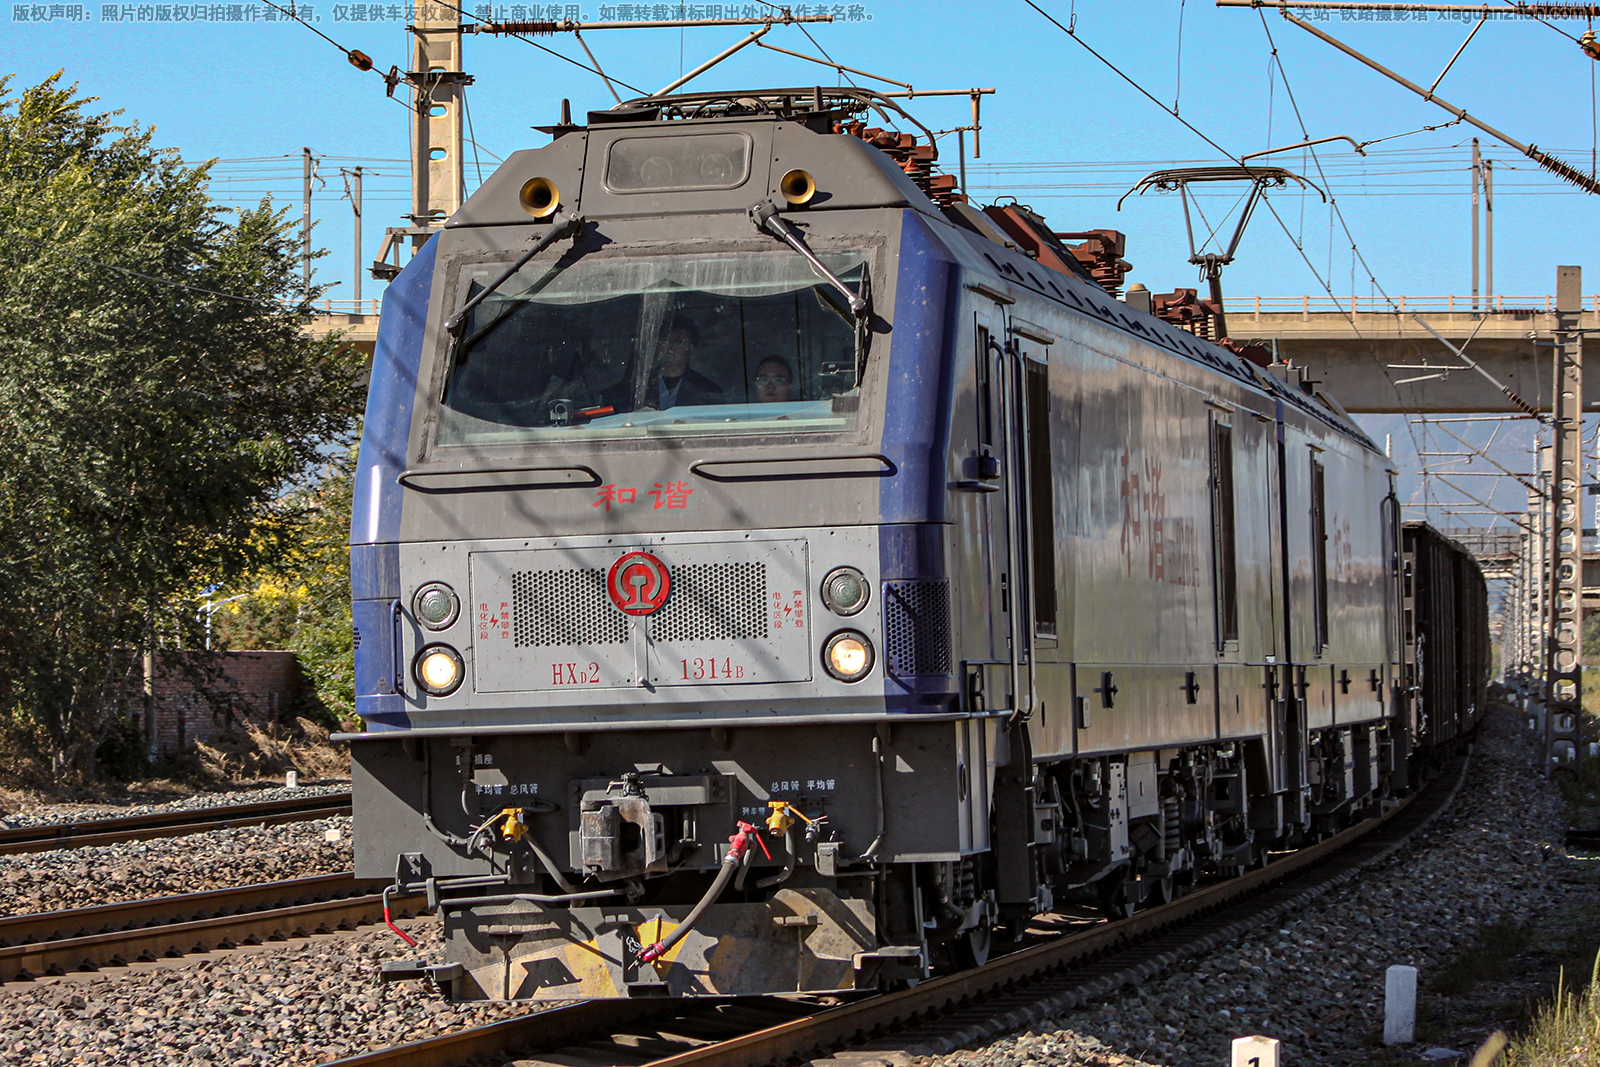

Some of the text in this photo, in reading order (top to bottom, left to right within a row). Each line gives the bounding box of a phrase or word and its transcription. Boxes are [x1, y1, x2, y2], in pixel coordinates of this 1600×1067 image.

[592, 480, 694, 512] 和谐
[479, 602, 489, 640] 电化区段
[500, 602, 510, 639] 严禁攀登
[772, 592, 783, 629] 电化区段
[552, 662, 600, 685] HXD2
[680, 656, 744, 681] 1314B
[475, 783, 538, 795] 平均管 总风管
[771, 779, 836, 792] 总风管 平均管
[742, 806, 766, 816] 列车管
